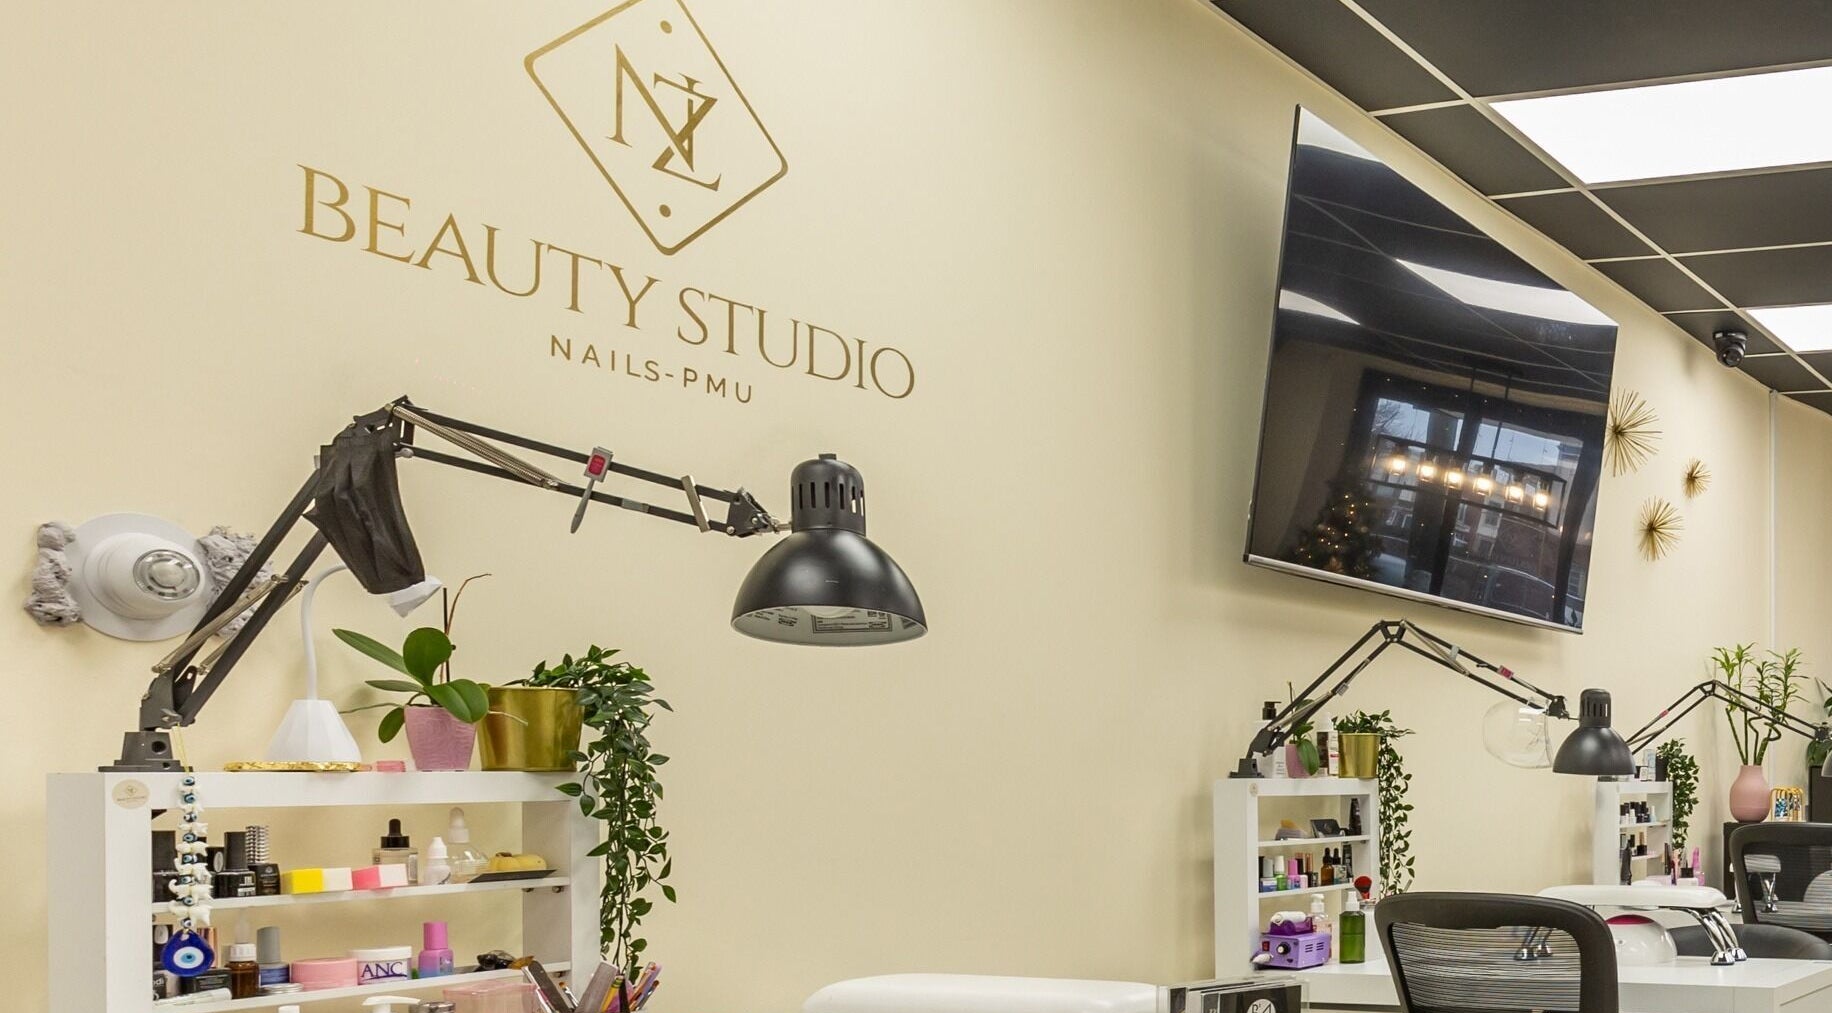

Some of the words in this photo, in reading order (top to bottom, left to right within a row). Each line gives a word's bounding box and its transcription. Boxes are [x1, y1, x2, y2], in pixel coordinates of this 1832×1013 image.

[296, 163, 661, 331] BEAUTY
[676, 286, 916, 401] STUDIO
[549, 334, 754, 406] NAILS-PMU
[361, 961, 406, 979] ANC
